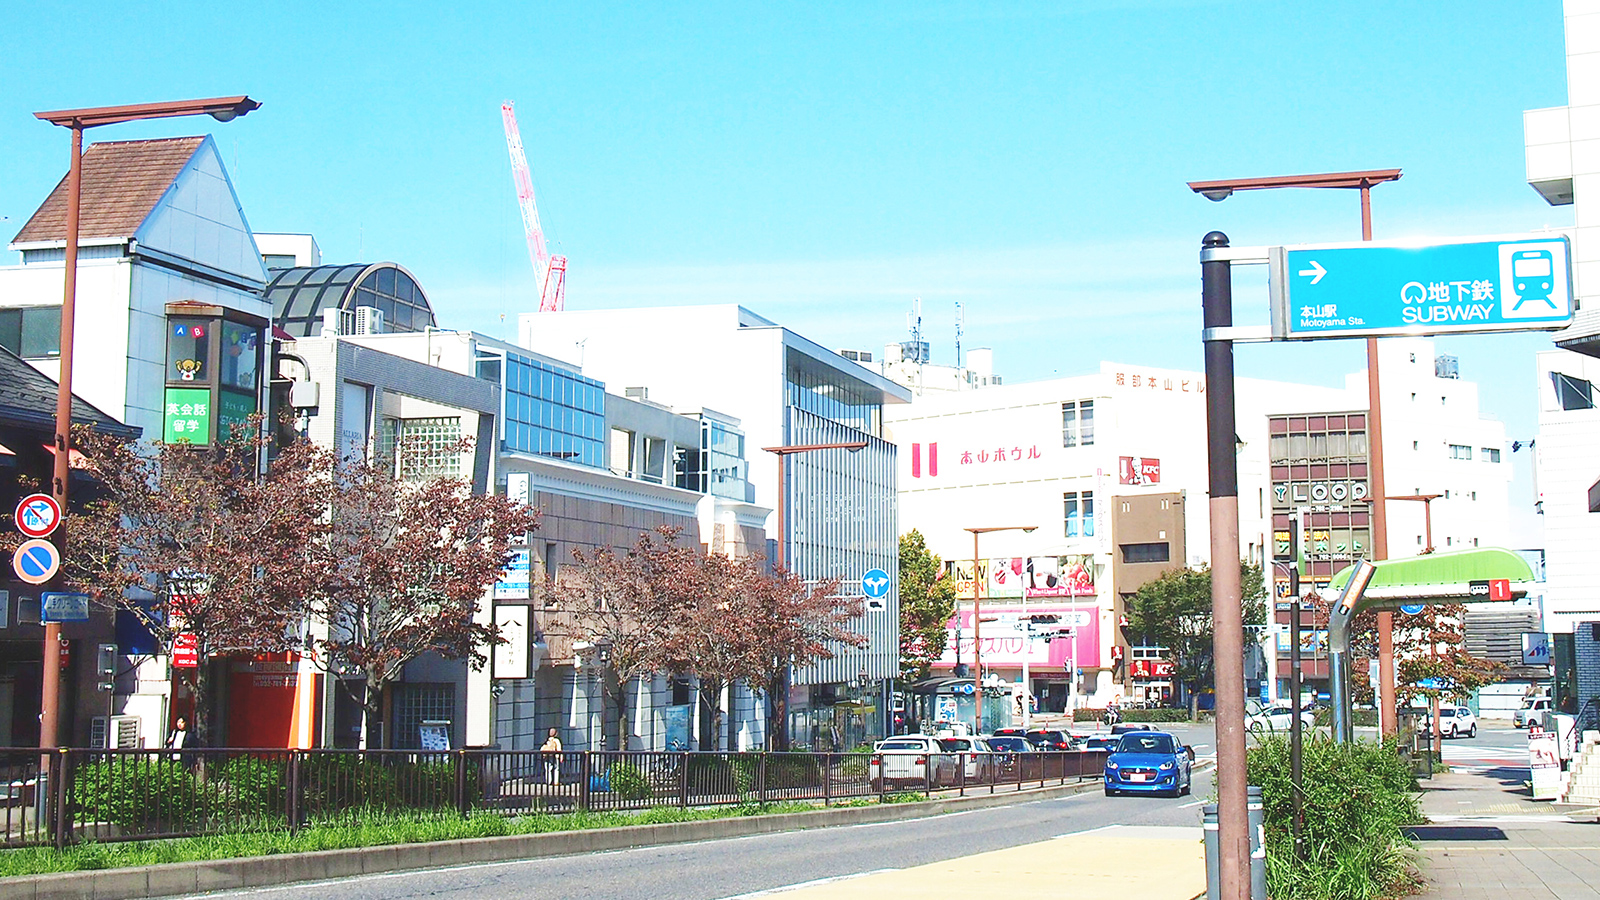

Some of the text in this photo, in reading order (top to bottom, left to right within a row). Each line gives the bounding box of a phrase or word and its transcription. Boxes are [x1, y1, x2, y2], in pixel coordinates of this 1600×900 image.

[1427, 279, 1495, 303] 地下鉄
[1300, 304, 1338, 318] 本山駅
[1402, 304, 1495, 324] SUBWAY
[1300, 315, 1366, 328] Motoyama Sta.
[177, 327, 184, 335] A
[194, 327, 201, 336] B
[1115, 372, 1206, 394] 服部本山ビル
[166, 403, 207, 416] 英会話
[173, 419, 200, 433] 留学
[960, 445, 1042, 465] 本山ボウル
[1143, 464, 1160, 475] KFC
[1292, 483, 1368, 502] LOOP
[956, 566, 986, 580] NEW
[956, 582, 984, 593] OPEN
[1495, 582, 1503, 597] 1
